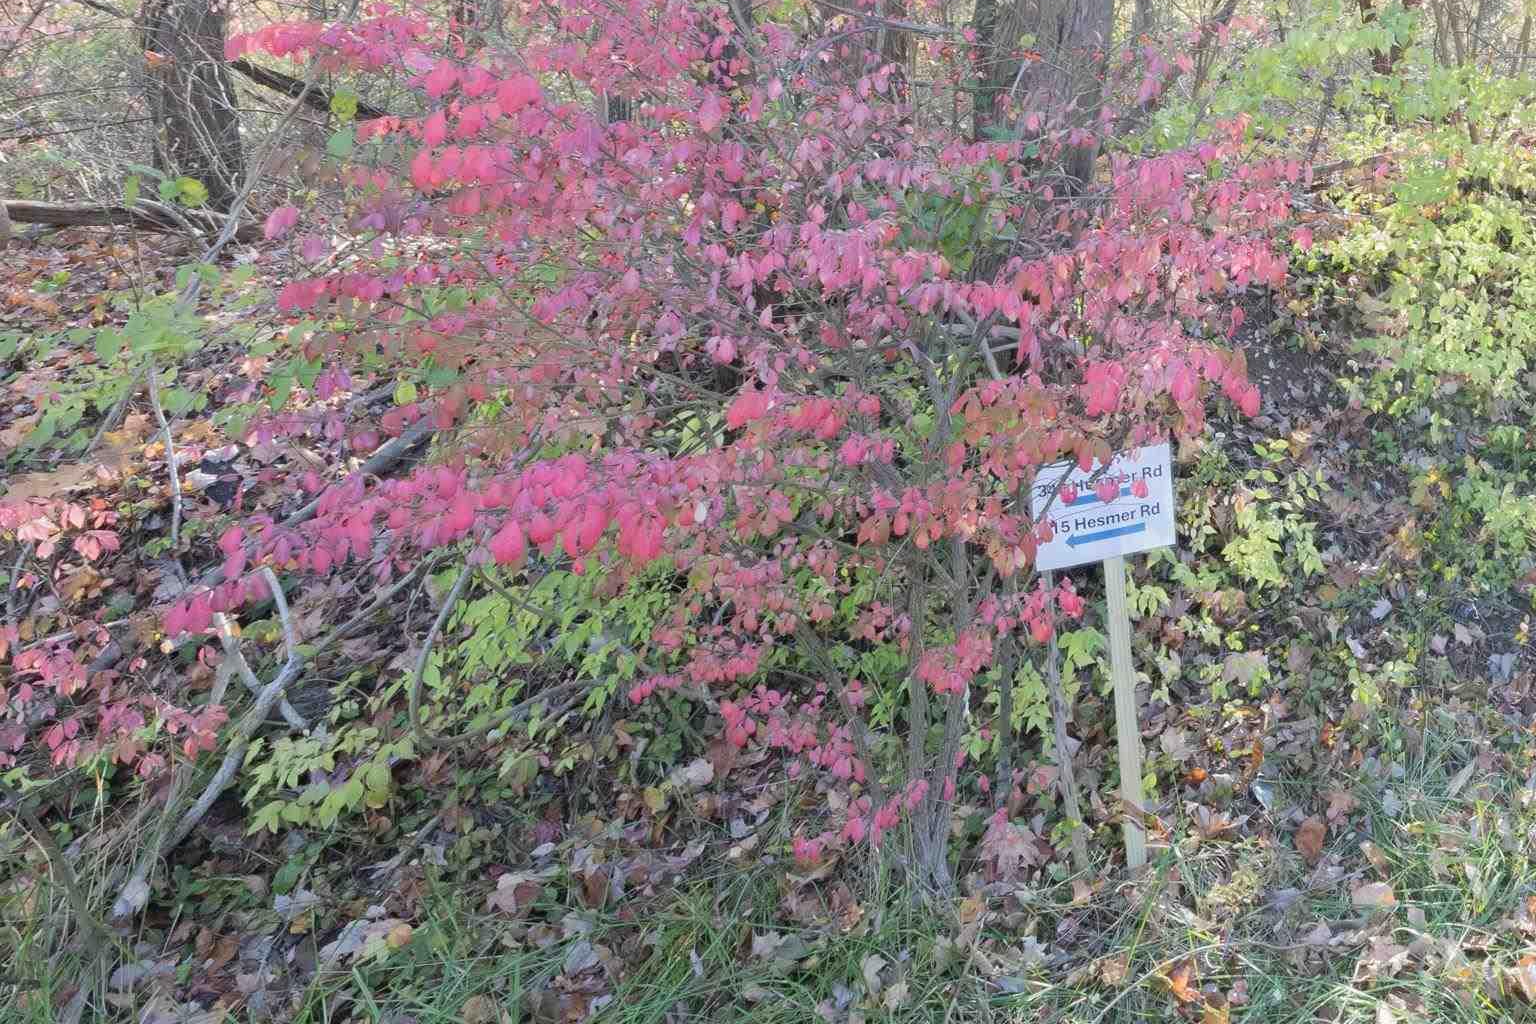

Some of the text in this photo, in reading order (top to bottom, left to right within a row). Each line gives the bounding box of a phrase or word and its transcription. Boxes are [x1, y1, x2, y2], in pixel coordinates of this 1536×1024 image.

[1072, 472, 1137, 491] Hmer
[1142, 464, 1162, 480] Rd
[1049, 502, 1160, 535] 15 Hesmer Rd
